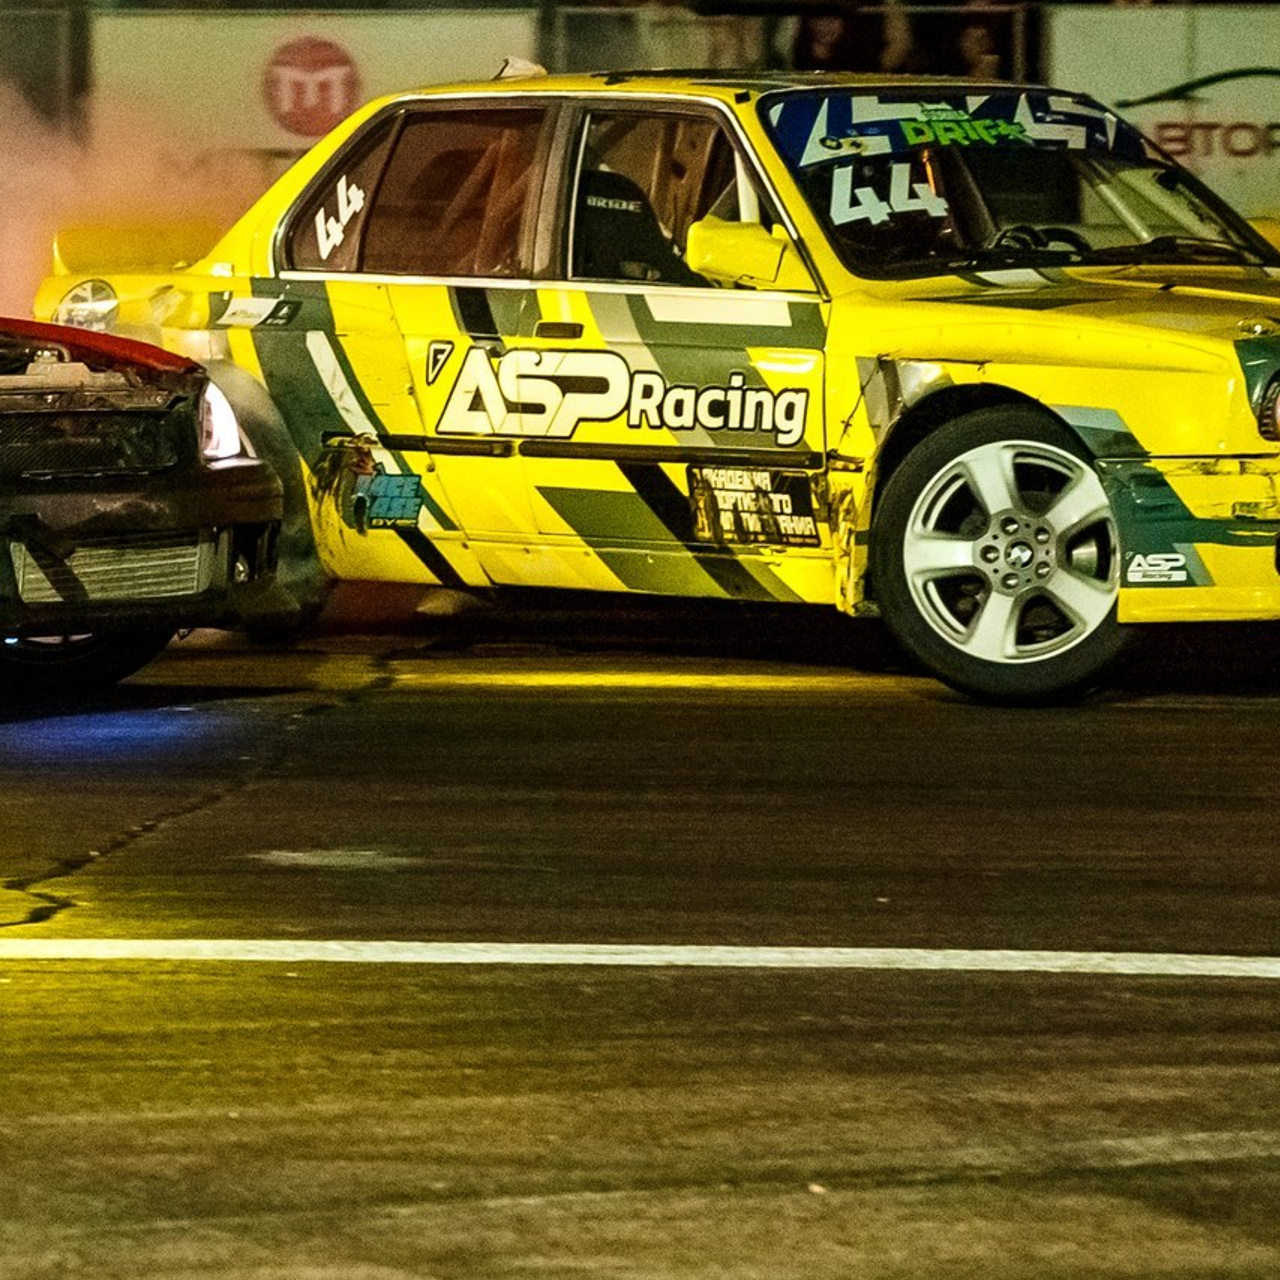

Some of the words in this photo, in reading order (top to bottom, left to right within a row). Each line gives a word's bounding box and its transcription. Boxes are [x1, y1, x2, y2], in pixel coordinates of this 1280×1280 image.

[314, 174, 365, 261] 44
[830, 163, 949, 225] 44
[435, 347, 631, 439] ASP
[627, 371, 810, 447] Racing
[1127, 553, 1186, 571] ASP
